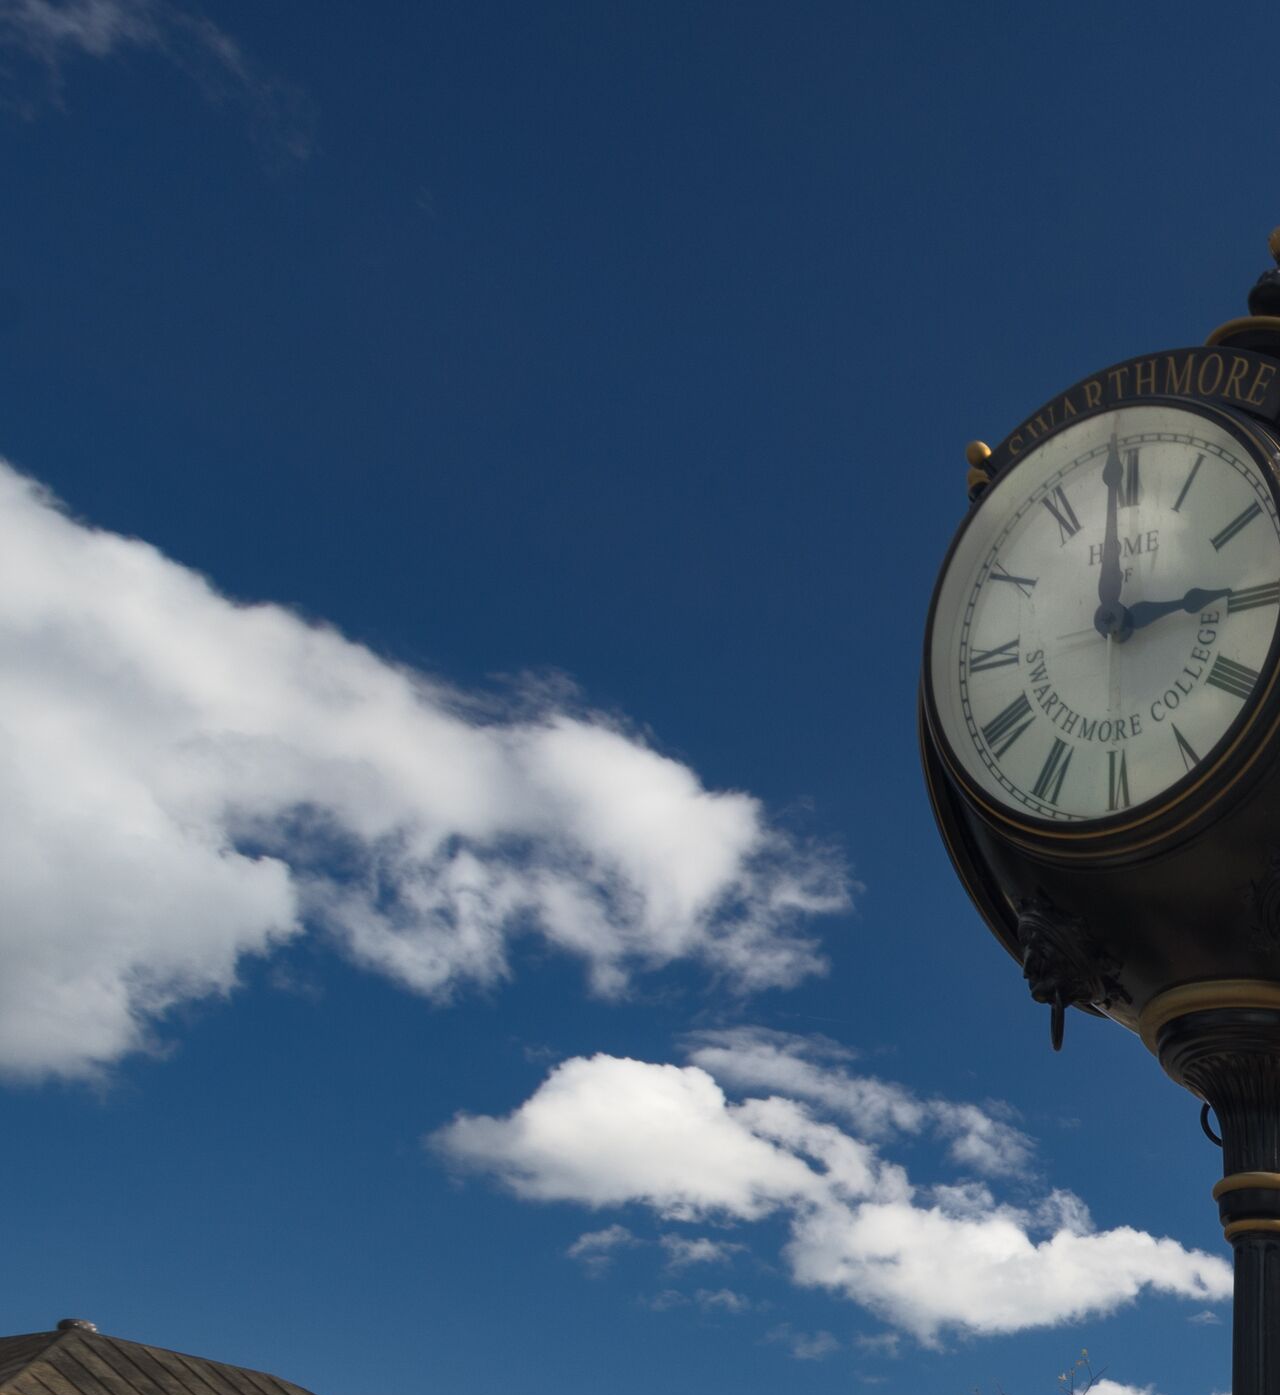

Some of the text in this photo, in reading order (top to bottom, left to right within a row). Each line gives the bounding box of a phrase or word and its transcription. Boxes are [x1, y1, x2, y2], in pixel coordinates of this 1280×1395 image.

[1088, 529, 1160, 567] HME
[1026, 609, 1221, 744] SWARTHMORE COLLEGE
